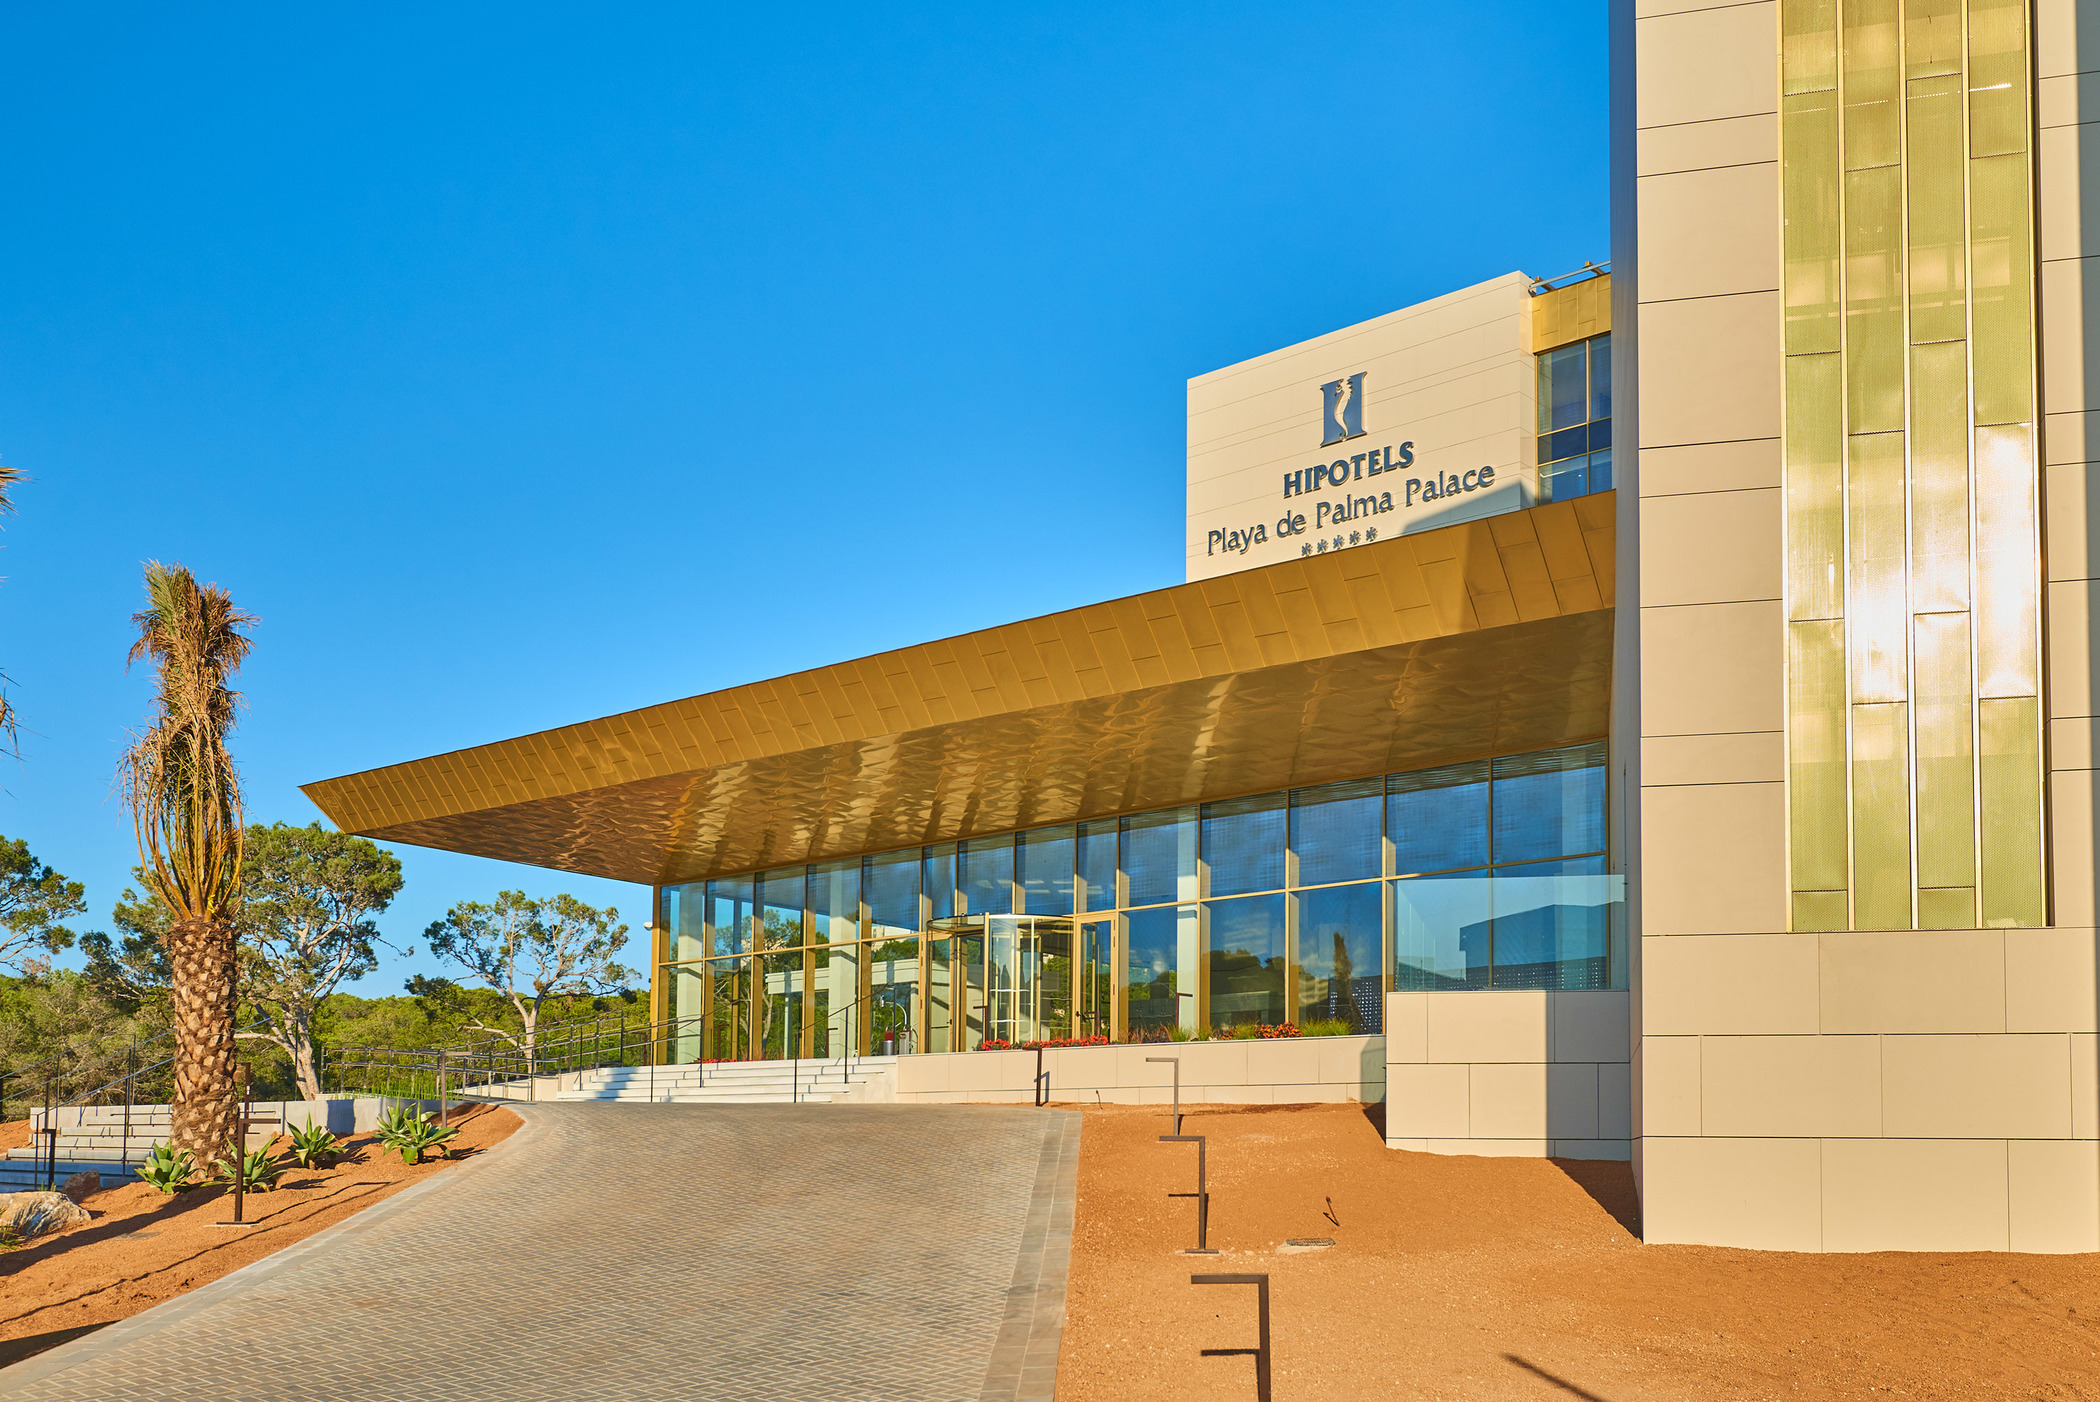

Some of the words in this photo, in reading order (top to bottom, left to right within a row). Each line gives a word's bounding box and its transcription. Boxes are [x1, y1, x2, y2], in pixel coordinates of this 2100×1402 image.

[1283, 441, 1414, 498] HIPOTELS
[1208, 524, 1268, 556] Playa
[1276, 510, 1306, 538] de
[1316, 494, 1394, 529] Palma
[1405, 465, 1495, 507] Palace
